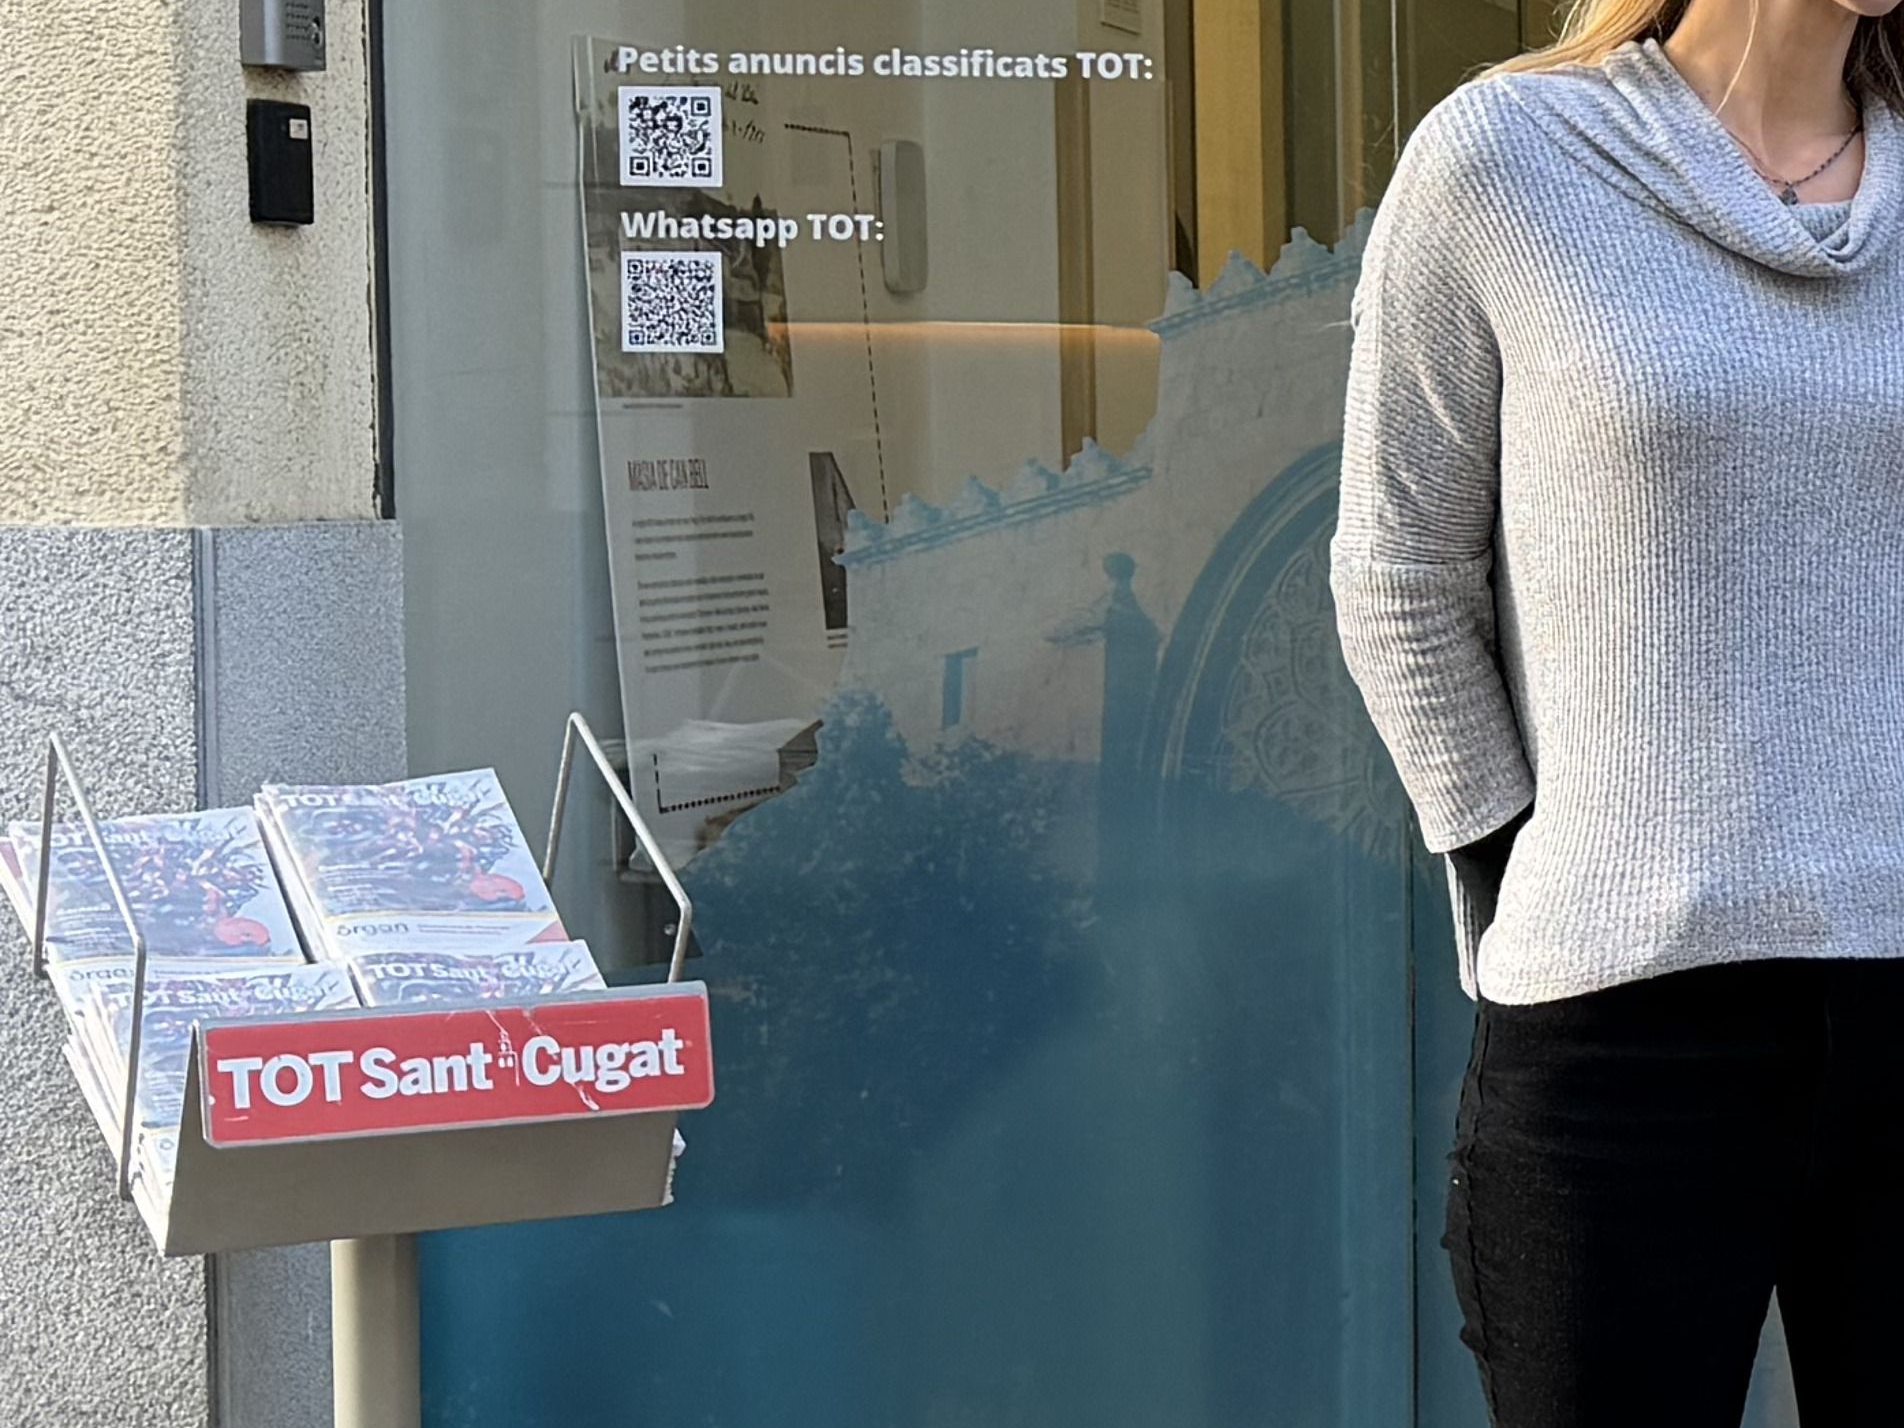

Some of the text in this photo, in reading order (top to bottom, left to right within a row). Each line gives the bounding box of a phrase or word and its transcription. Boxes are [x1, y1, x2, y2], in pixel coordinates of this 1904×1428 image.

[618, 45, 1153, 80] Petits anuncis classificats TOT:
[621, 211, 885, 246] Whatsapp TOT:
[217, 1050, 354, 1109] TOT
[359, 1042, 494, 1099] Sant
[521, 1028, 685, 1095] Cugat
